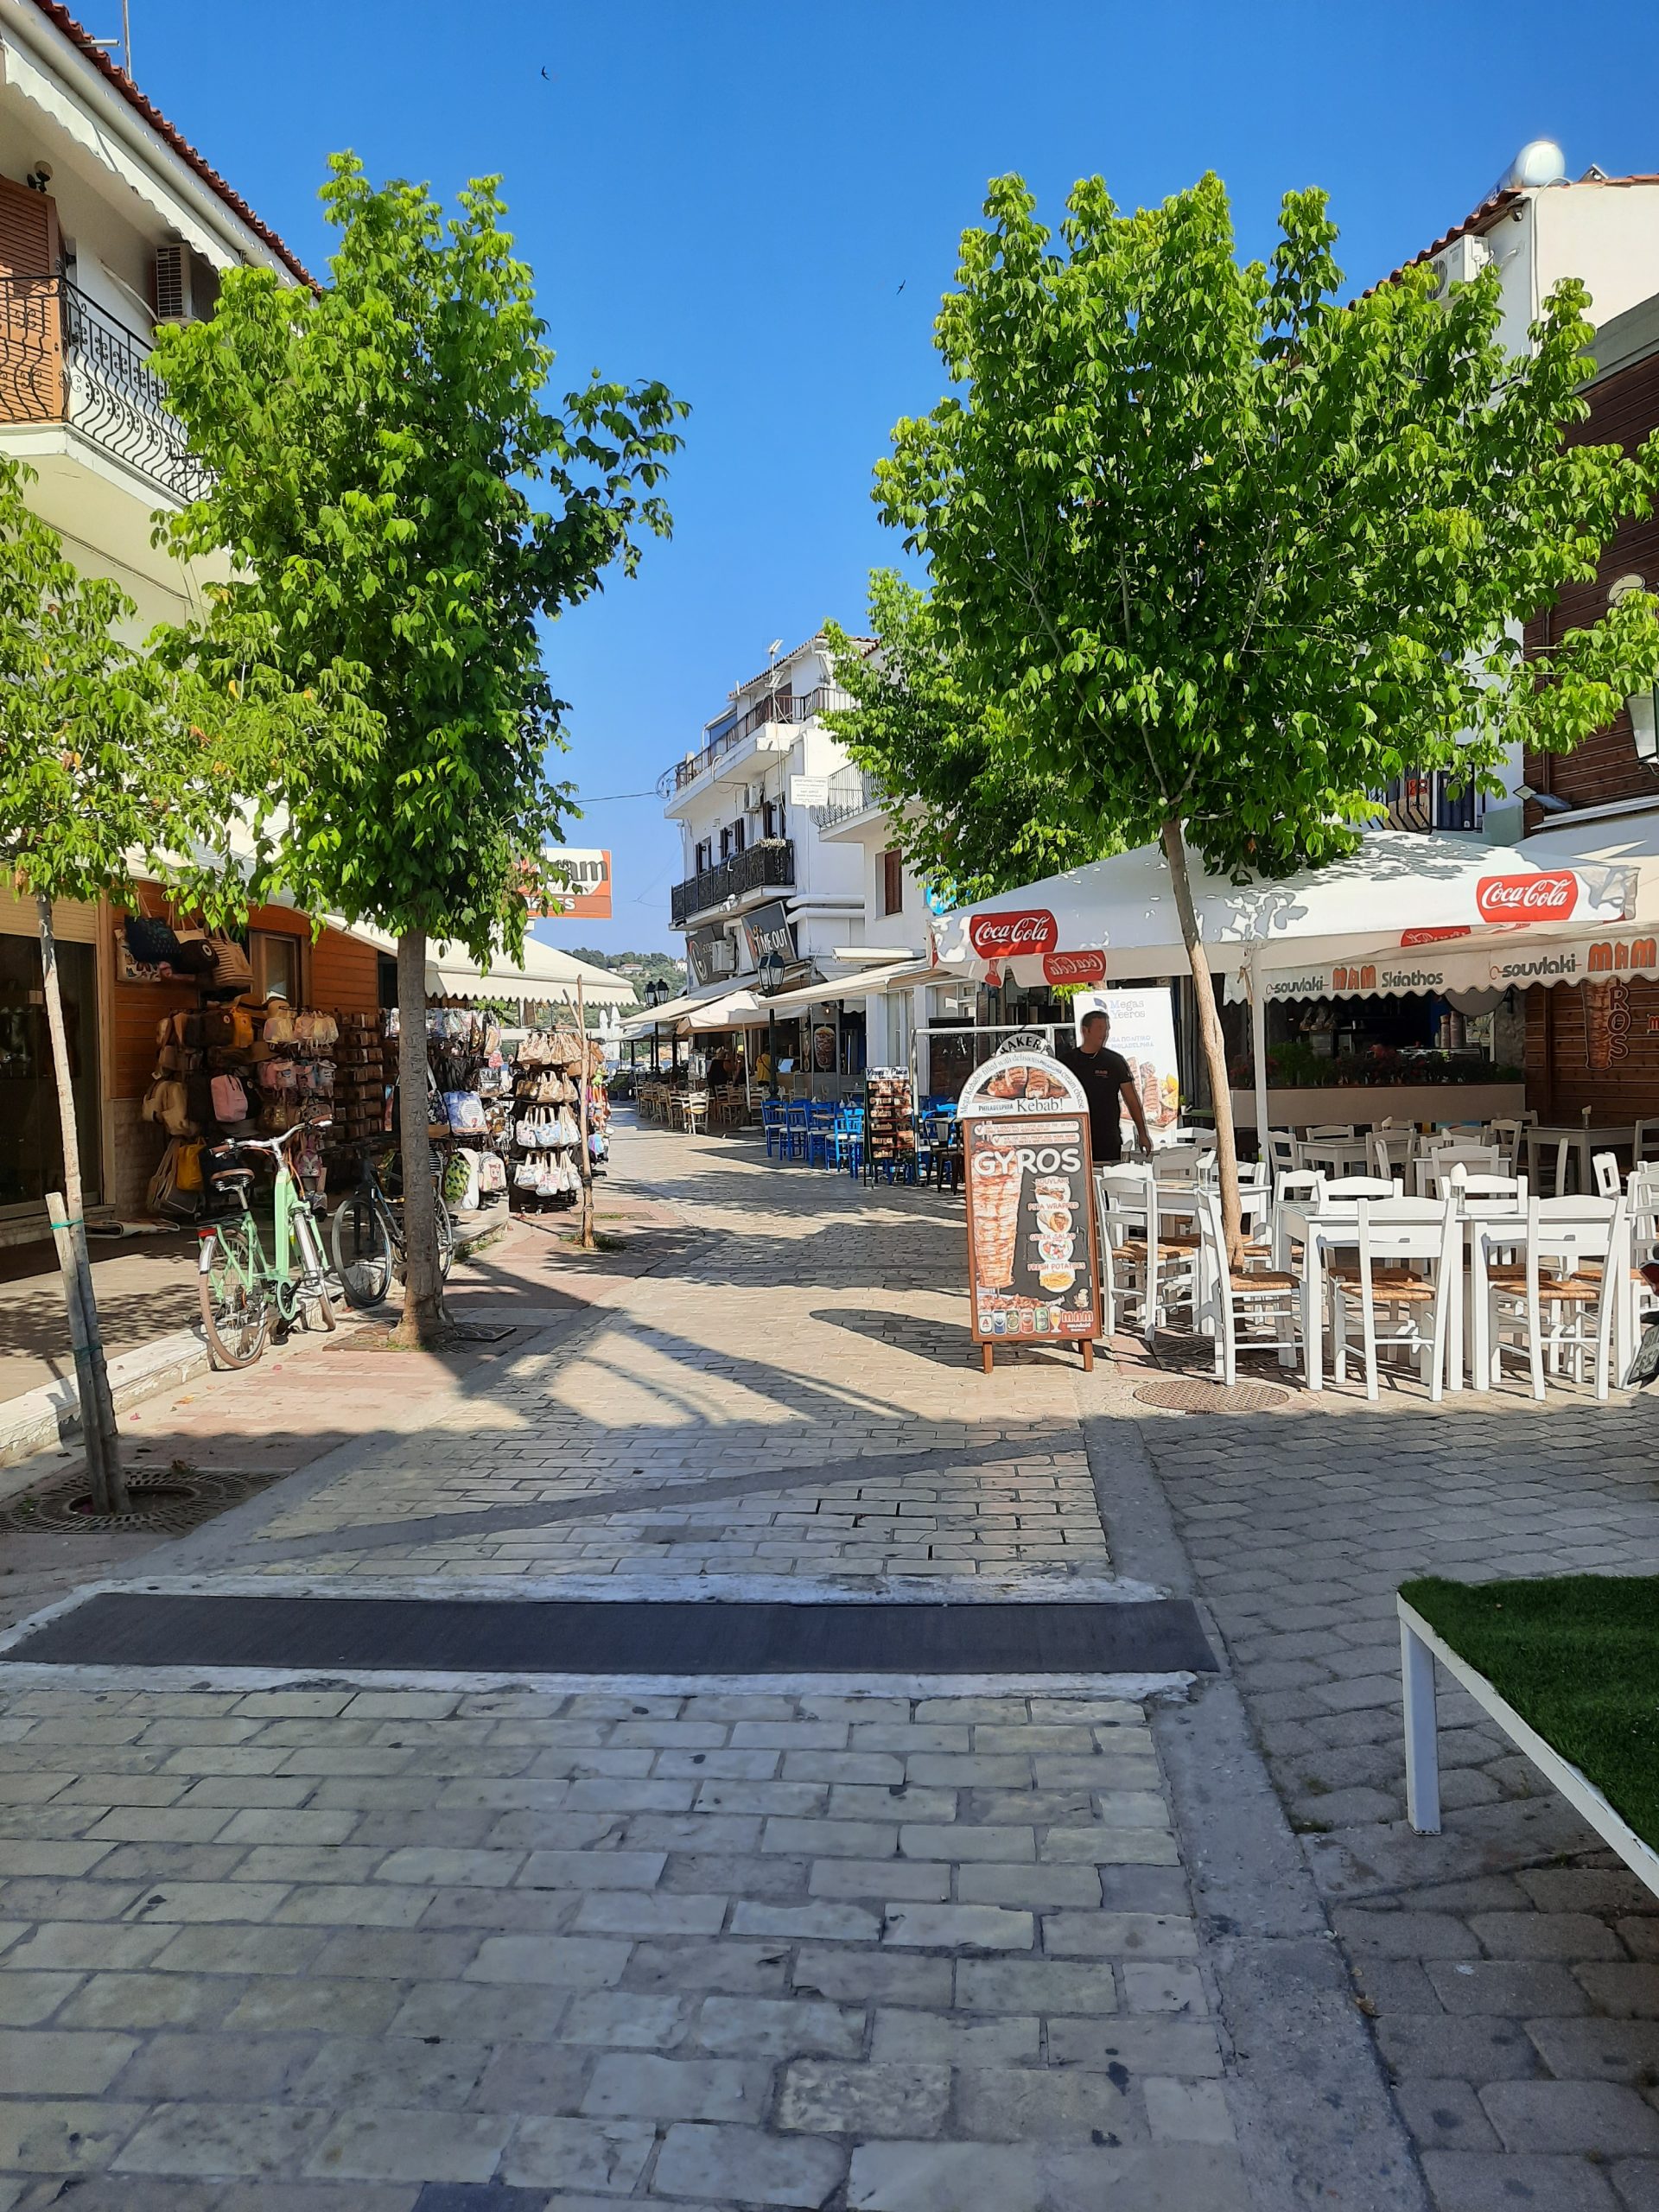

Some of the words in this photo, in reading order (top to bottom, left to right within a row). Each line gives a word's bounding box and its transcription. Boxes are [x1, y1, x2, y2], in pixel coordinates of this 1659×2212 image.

[1481, 879, 1573, 909] Coca-Cola
[772, 927, 788, 949] OUT
[975, 916, 1051, 946] Coca-Cola
[1502, 953, 1576, 977] souvlaki
[1274, 976, 1324, 994] souvlaki
[1382, 969, 1444, 988] Skiathos
[1109, 1001, 1144, 1011] Megas
[1112, 1010, 1146, 1019] Yeeros
[982, 1062, 998, 1076] filled
[1061, 1071, 1077, 1090] cream
[978, 1103, 1014, 1112] PHILADELPHIA
[1017, 1097, 1064, 1112] Kebab!
[974, 1147, 1082, 1175] GYROS
